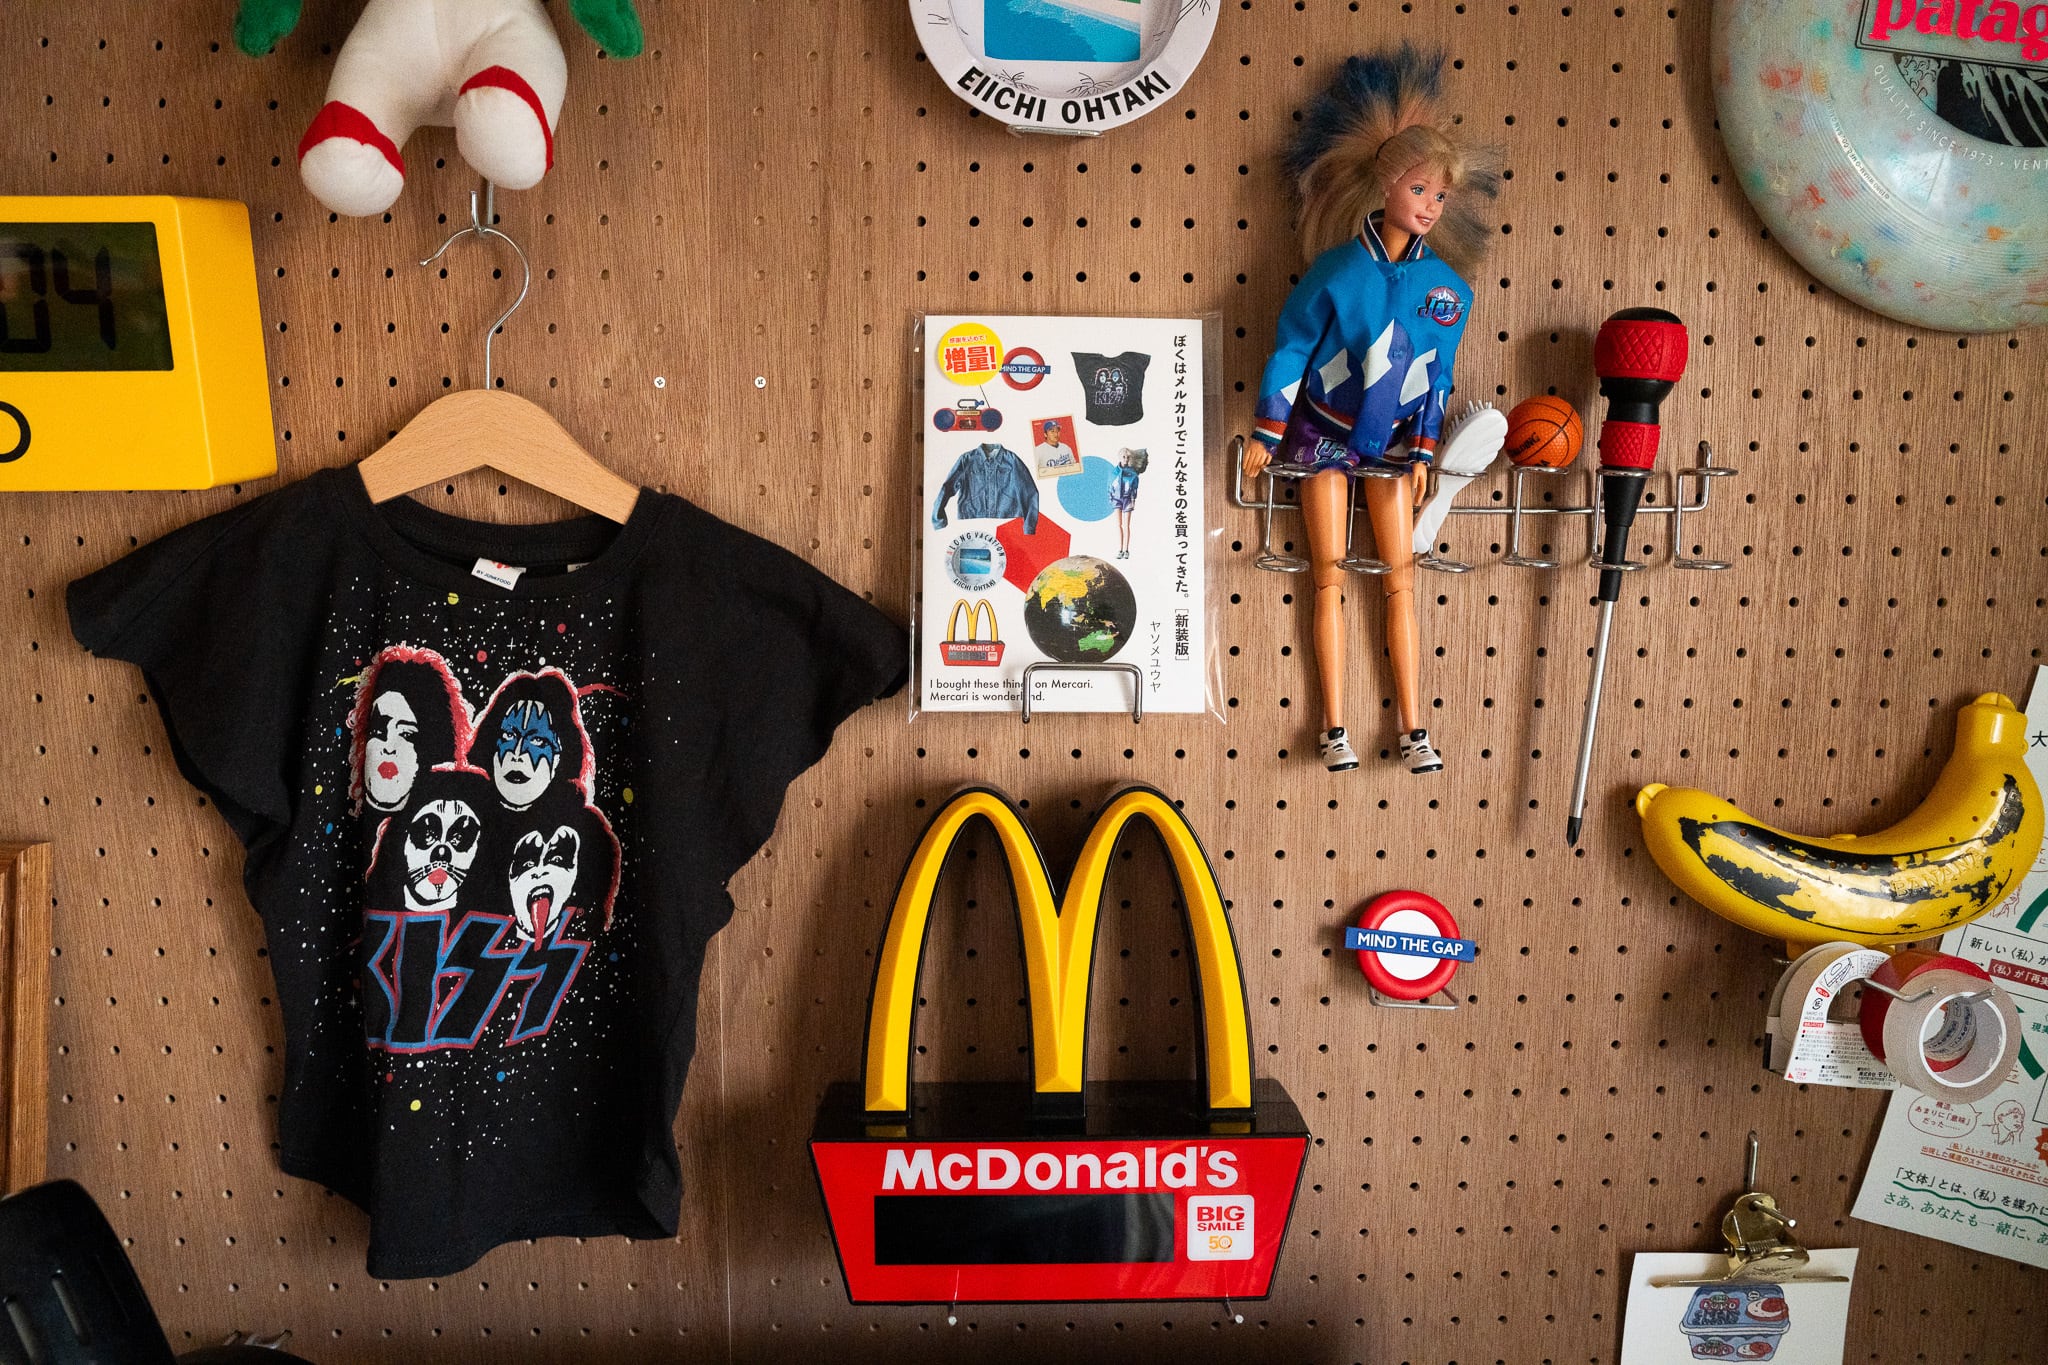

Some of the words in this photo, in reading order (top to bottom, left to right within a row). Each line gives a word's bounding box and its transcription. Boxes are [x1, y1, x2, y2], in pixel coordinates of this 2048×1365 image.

[956, 66, 1047, 122] EIICHI
[1061, 70, 1172, 124] OHTAKI
[1874, 64, 1917, 121] QUALITY
[1917, 121, 1957, 152] SINCE
[1962, 148, 1994, 166] 1973
[945, 345, 997, 374] 増量!
[1032, 366, 1046, 374] GAP
[1173, 334, 1190, 599] ぼくはメルカリでこんなものを買ってきた。
[948, 532, 972, 551] LONG
[1150, 620, 1163, 694] ヤソメユウヤ
[930, 679, 933, 688] I
[936, 679, 971, 691] bought
[974, 679, 1000, 688] these
[1002, 679, 1026, 690] thing
[1051, 679, 1093, 689] Mercari.
[930, 692, 969, 701] Mercari
[972, 692, 979, 701] is
[982, 692, 1045, 701] wonderlnd.
[1357, 932, 1397, 949] MIND
[1399, 937, 1430, 953] THE
[1431, 940, 1464, 957] GAP
[882, 1147, 1239, 1190] McDonald's
[1197, 1206, 1245, 1221] BIG
[1197, 1222, 1245, 1232] SMILE
